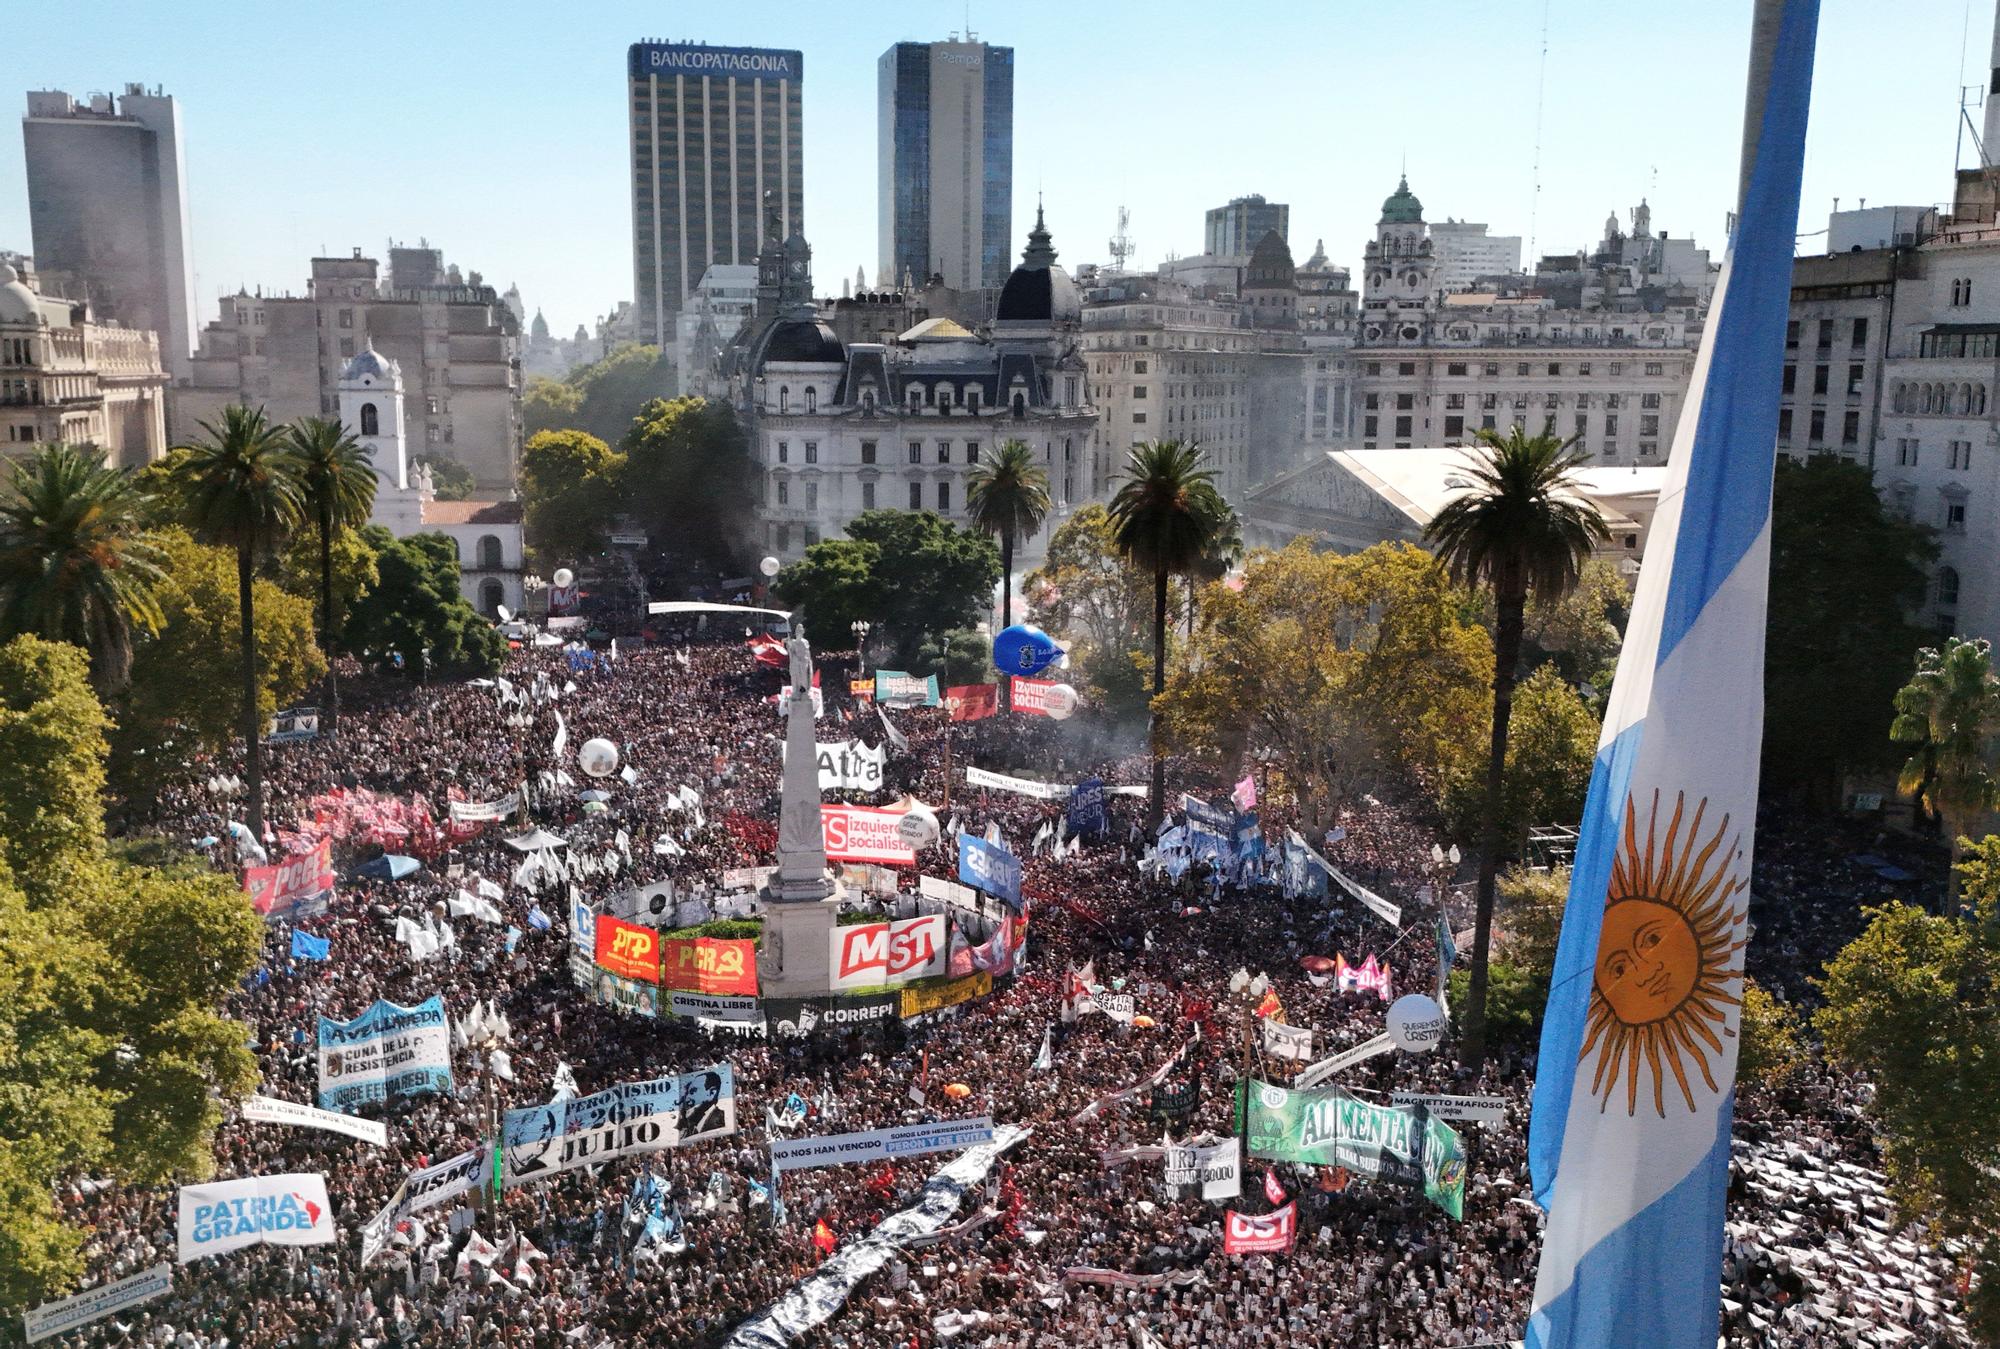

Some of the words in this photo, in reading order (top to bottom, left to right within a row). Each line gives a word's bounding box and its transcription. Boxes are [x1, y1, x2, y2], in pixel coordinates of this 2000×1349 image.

[941, 51, 980, 67] Pampa
[679, 945, 718, 972] PCR
[847, 925, 936, 970] MST
[673, 996, 719, 1009] CRISTINA
[722, 1001, 753, 1009] LIBRE
[823, 1003, 893, 1023] CORREPI
[1404, 1029, 1441, 1042] CRISTIN
[345, 1045, 378, 1060] CUNA
[382, 1041, 396, 1054] DE
[398, 1038, 409, 1049] LA
[344, 1050, 416, 1075] RESISTENCIA
[564, 1081, 671, 1116] PERONISMO
[1455, 1101, 1504, 1109] MAFIOSO
[591, 1102, 626, 1130] 26
[630, 1103, 654, 1120] DE
[558, 1122, 660, 1162] JULIO
[891, 1131, 916, 1139] SOMOS
[916, 1128, 930, 1137] LOS
[932, 1125, 974, 1134] HEREDEROS
[773, 1152, 789, 1160] NO
[791, 1147, 812, 1158] NOS
[814, 1145, 836, 1155] HAN
[838, 1140, 882, 1152] VENCIDO
[195, 1193, 299, 1226] PATRIA
[192, 1210, 312, 1243] GRANDE
[41, 1301, 78, 1319] SOMOS
[79, 1295, 93, 1306] DE
[94, 1291, 107, 1301] LA
[109, 1273, 157, 1295] GLORIOSA
